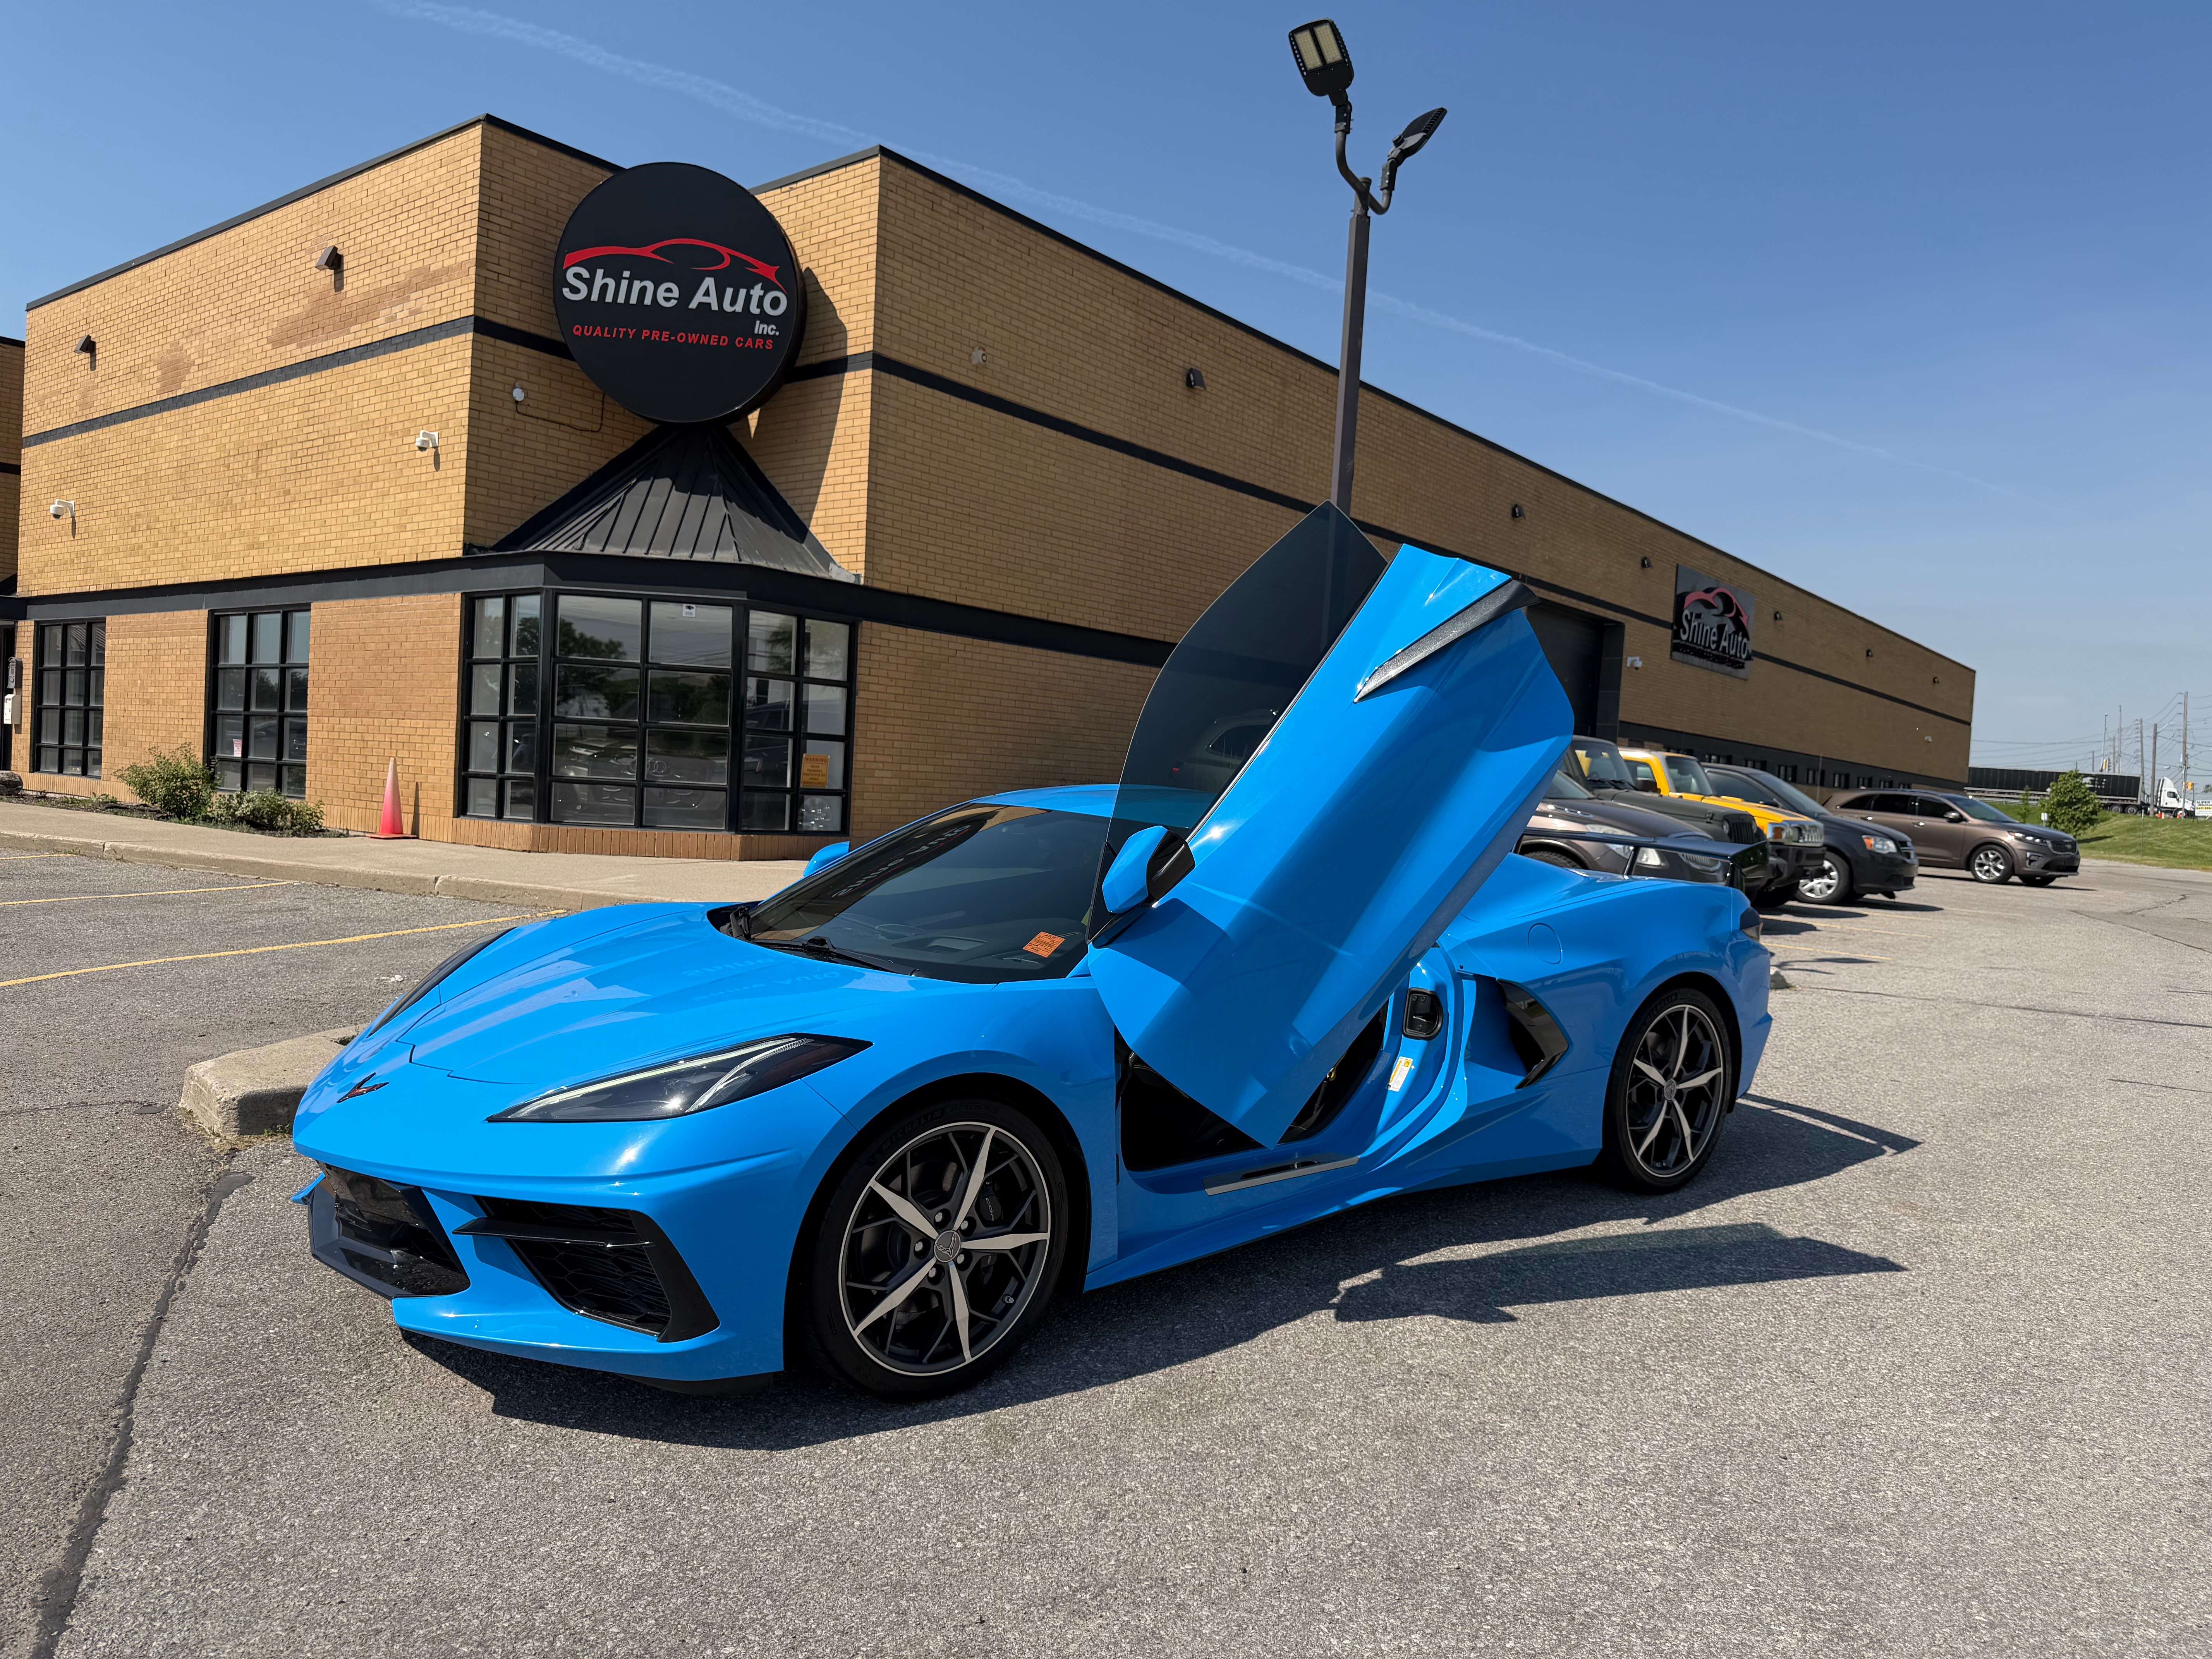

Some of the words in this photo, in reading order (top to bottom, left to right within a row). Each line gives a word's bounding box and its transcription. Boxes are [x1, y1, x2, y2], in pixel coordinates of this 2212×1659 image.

[562, 266, 679, 307] Shine
[688, 277, 787, 316] Auto
[573, 325, 636, 339] QUALITY
[641, 329, 728, 346] PRE-OWNED
[735, 337, 773, 349] CARS
[754, 320, 779, 336] Inc.
[1680, 610, 1718, 649] Shine
[1719, 624, 1749, 659] Auto
